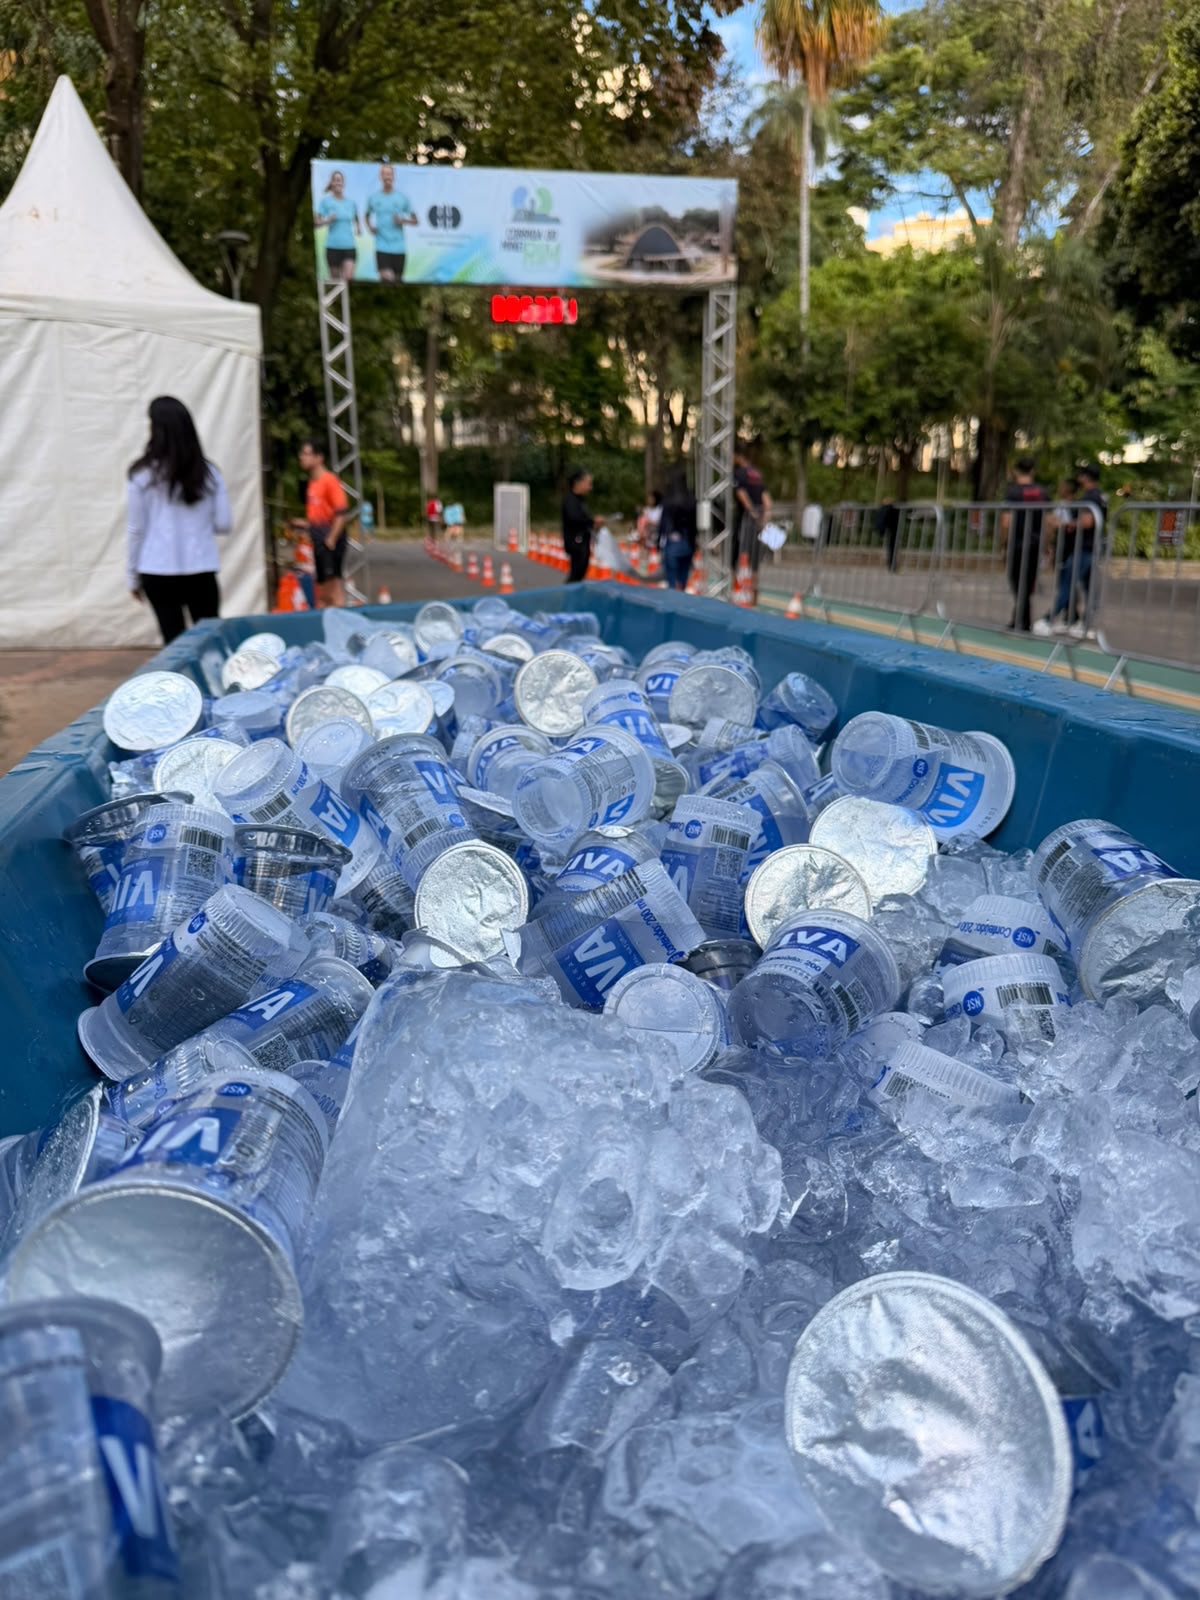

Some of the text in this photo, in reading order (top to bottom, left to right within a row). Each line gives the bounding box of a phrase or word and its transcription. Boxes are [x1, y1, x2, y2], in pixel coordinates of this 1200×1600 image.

[647, 677, 678, 691] VI
[421, 770, 460, 798] VI
[319, 791, 352, 832] VA
[923, 772, 975, 824] VIV
[558, 851, 625, 877] IVA
[1099, 849, 1170, 874] VA
[111, 869, 155, 913] VI
[640, 909, 656, 926] 200
[959, 920, 1034, 945] NSF Conteúdo: 200
[779, 930, 848, 964] IVA
[573, 925, 627, 1000] VA
[804, 959, 822, 972] 200
[966, 995, 982, 1011] NSF
[120, 1117, 220, 1164] VI
